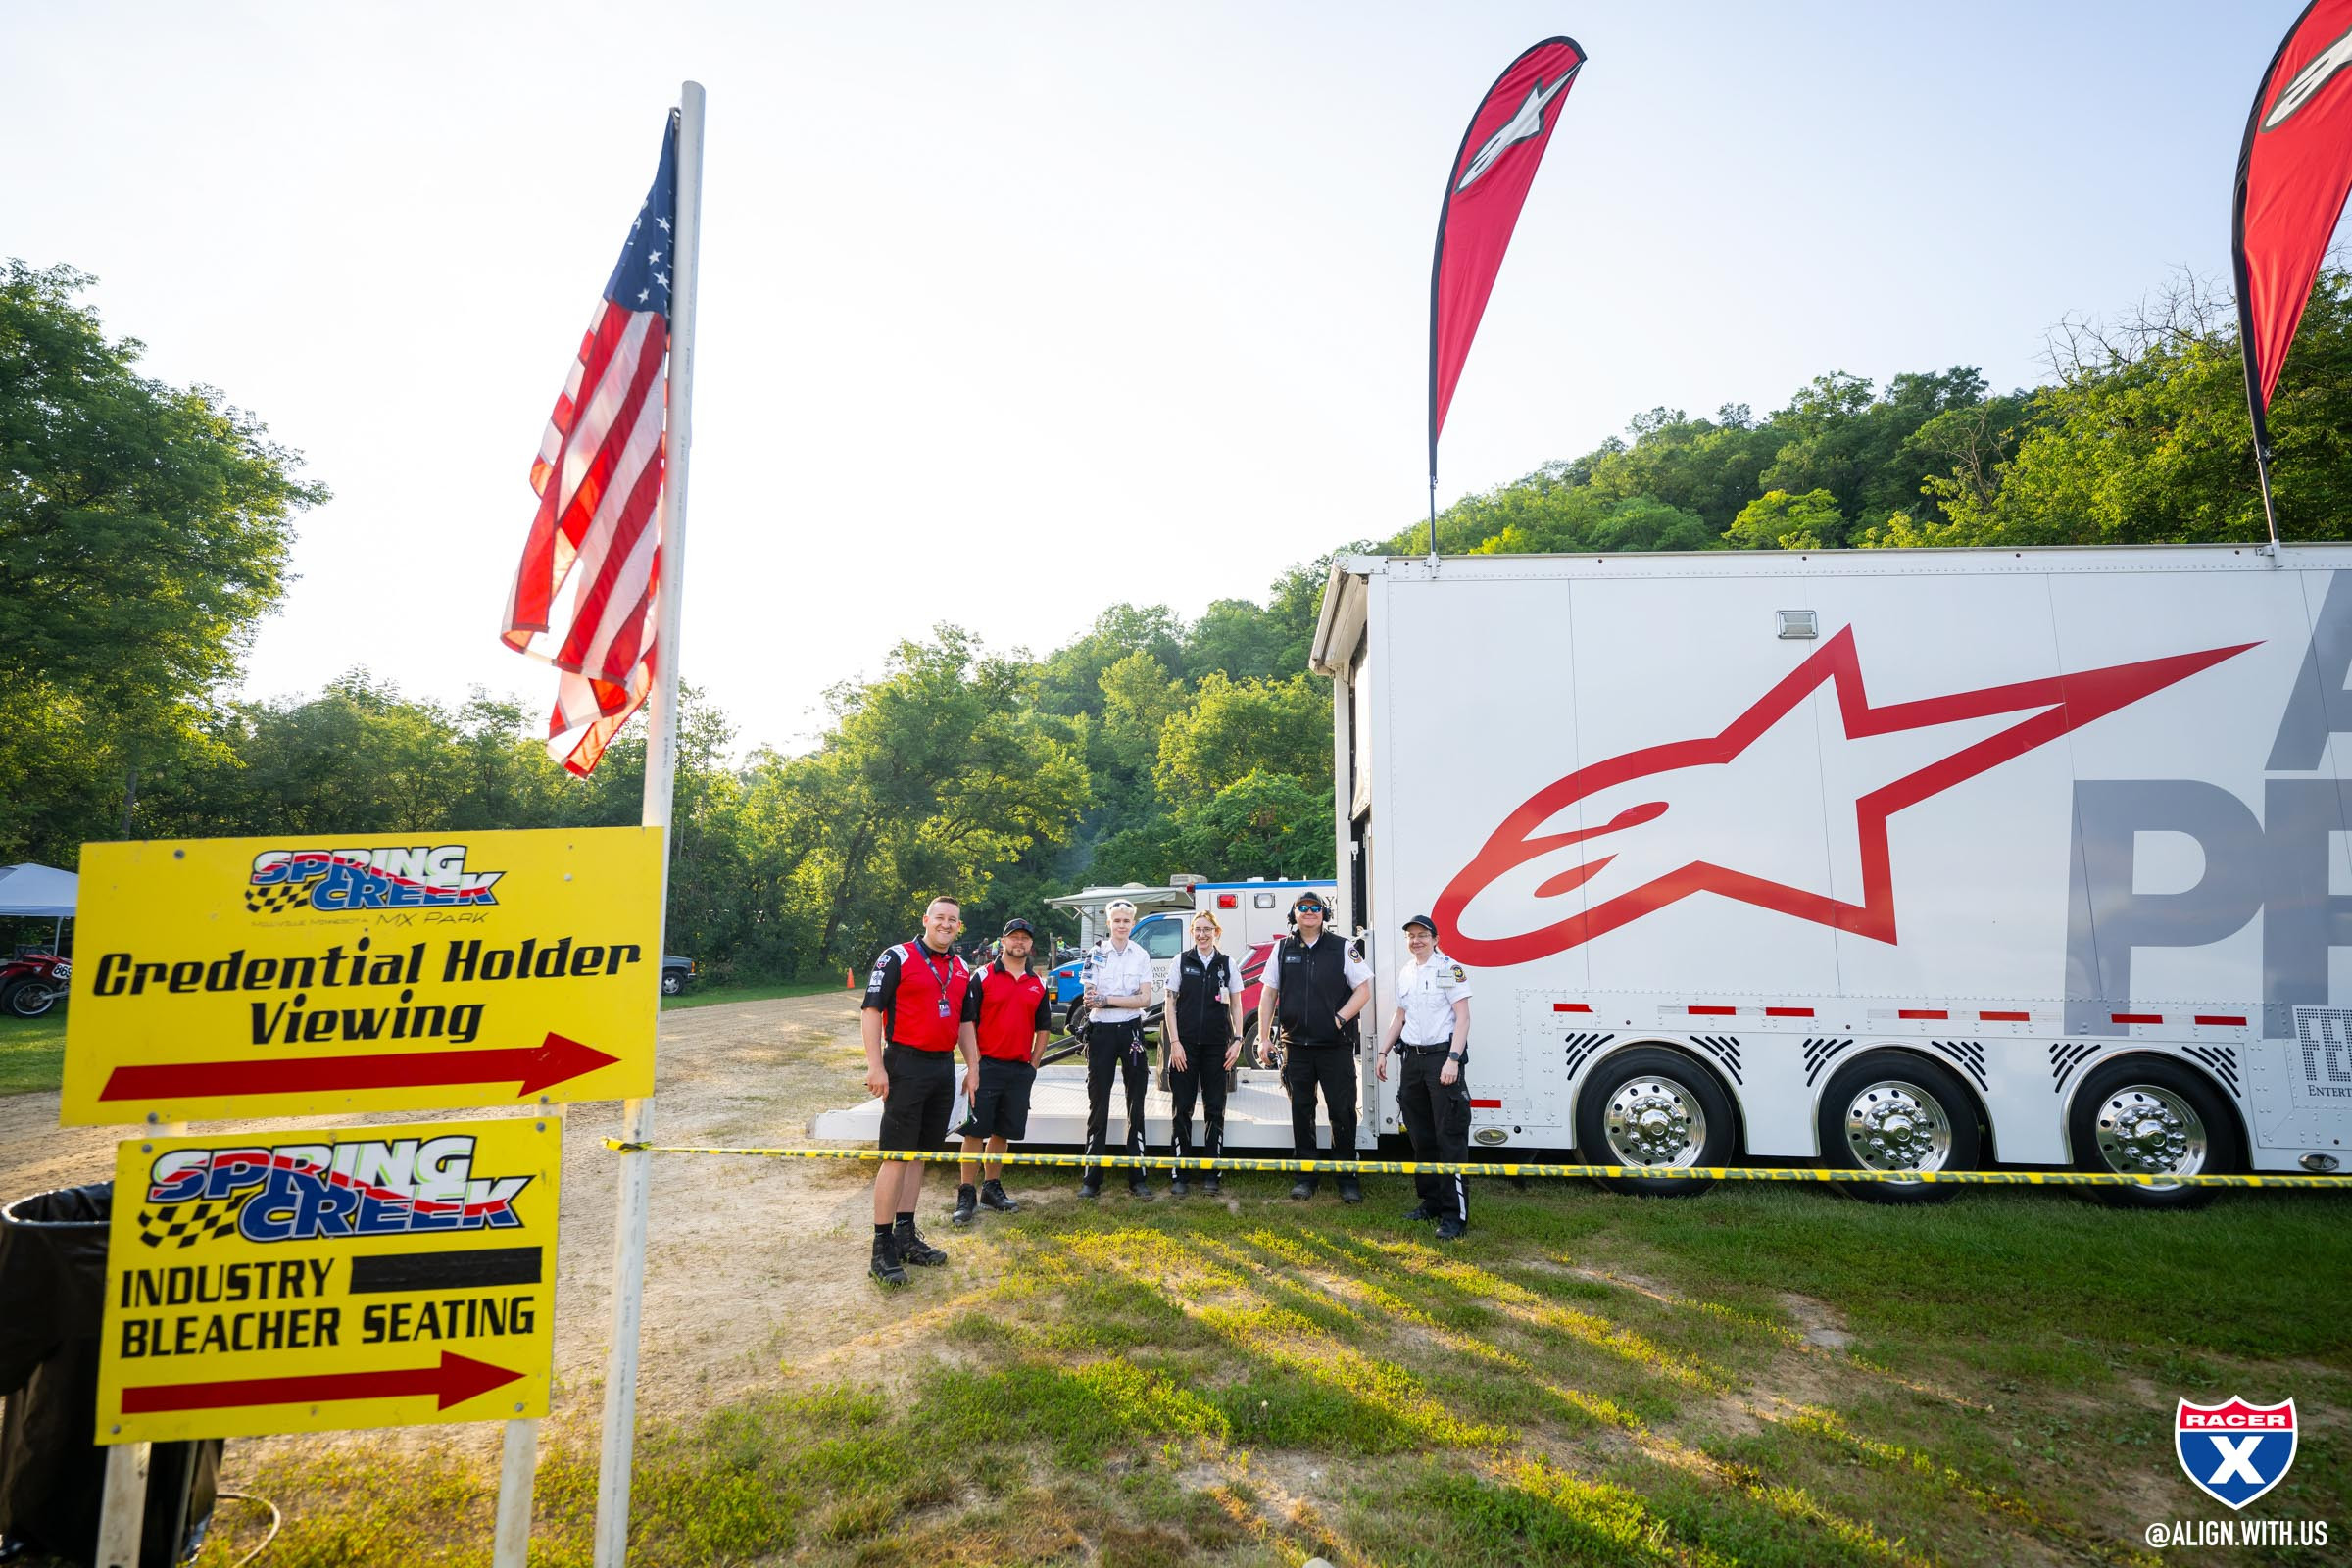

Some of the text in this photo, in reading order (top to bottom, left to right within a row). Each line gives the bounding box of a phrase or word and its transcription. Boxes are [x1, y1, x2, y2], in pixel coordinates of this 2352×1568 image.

[250, 845, 467, 886] SPRING
[310, 870, 508, 912] CREEK
[375, 911, 419, 928] MX
[423, 911, 490, 924] PARK
[93, 937, 640, 996] Credential Holder
[252, 989, 485, 1045] Viewing
[2296, 1008, 2352, 1082] FE
[145, 1135, 476, 1204] SPRING
[238, 1174, 537, 1245] CREEK
[120, 1258, 335, 1309] INDUSTRY
[120, 1296, 535, 1359] BLEACHER SEATING
